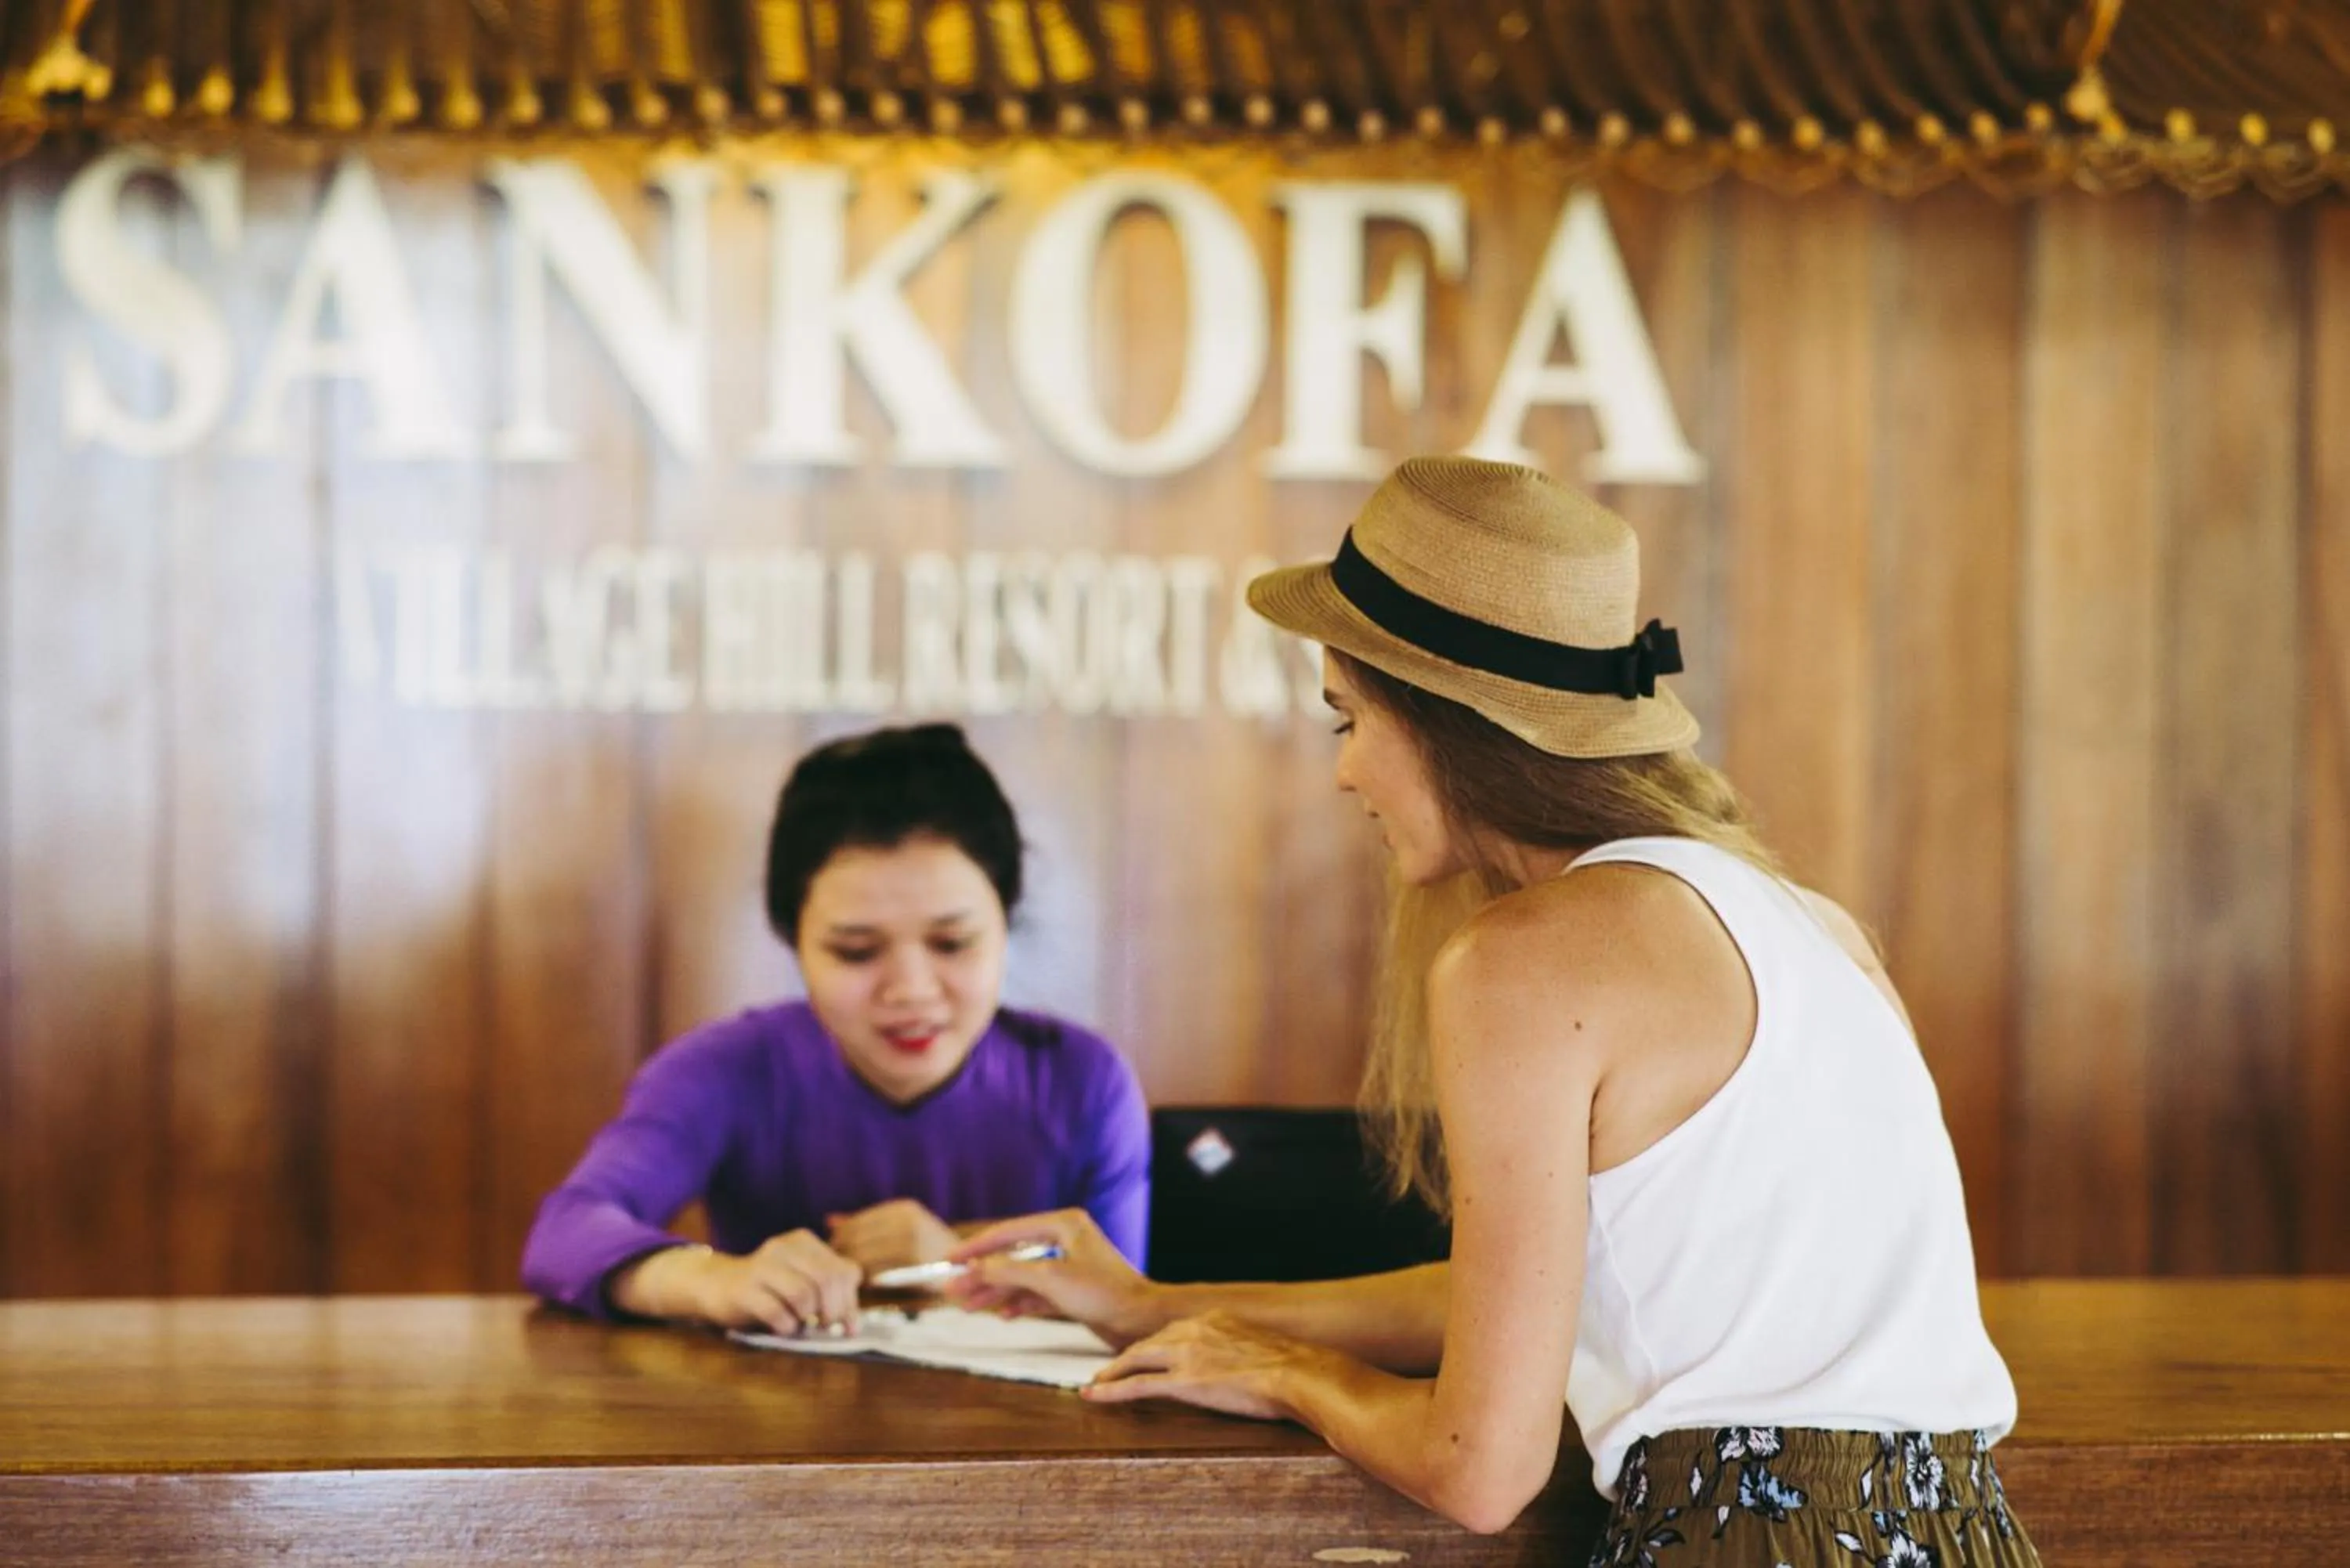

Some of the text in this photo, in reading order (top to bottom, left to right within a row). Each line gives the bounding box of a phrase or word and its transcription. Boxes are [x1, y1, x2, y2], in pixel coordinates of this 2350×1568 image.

[55, 146, 1705, 482] SANKOFA
[335, 546, 694, 711] VILLAGE
[704, 547, 896, 713] HILL
[901, 551, 1224, 716] RESORT
